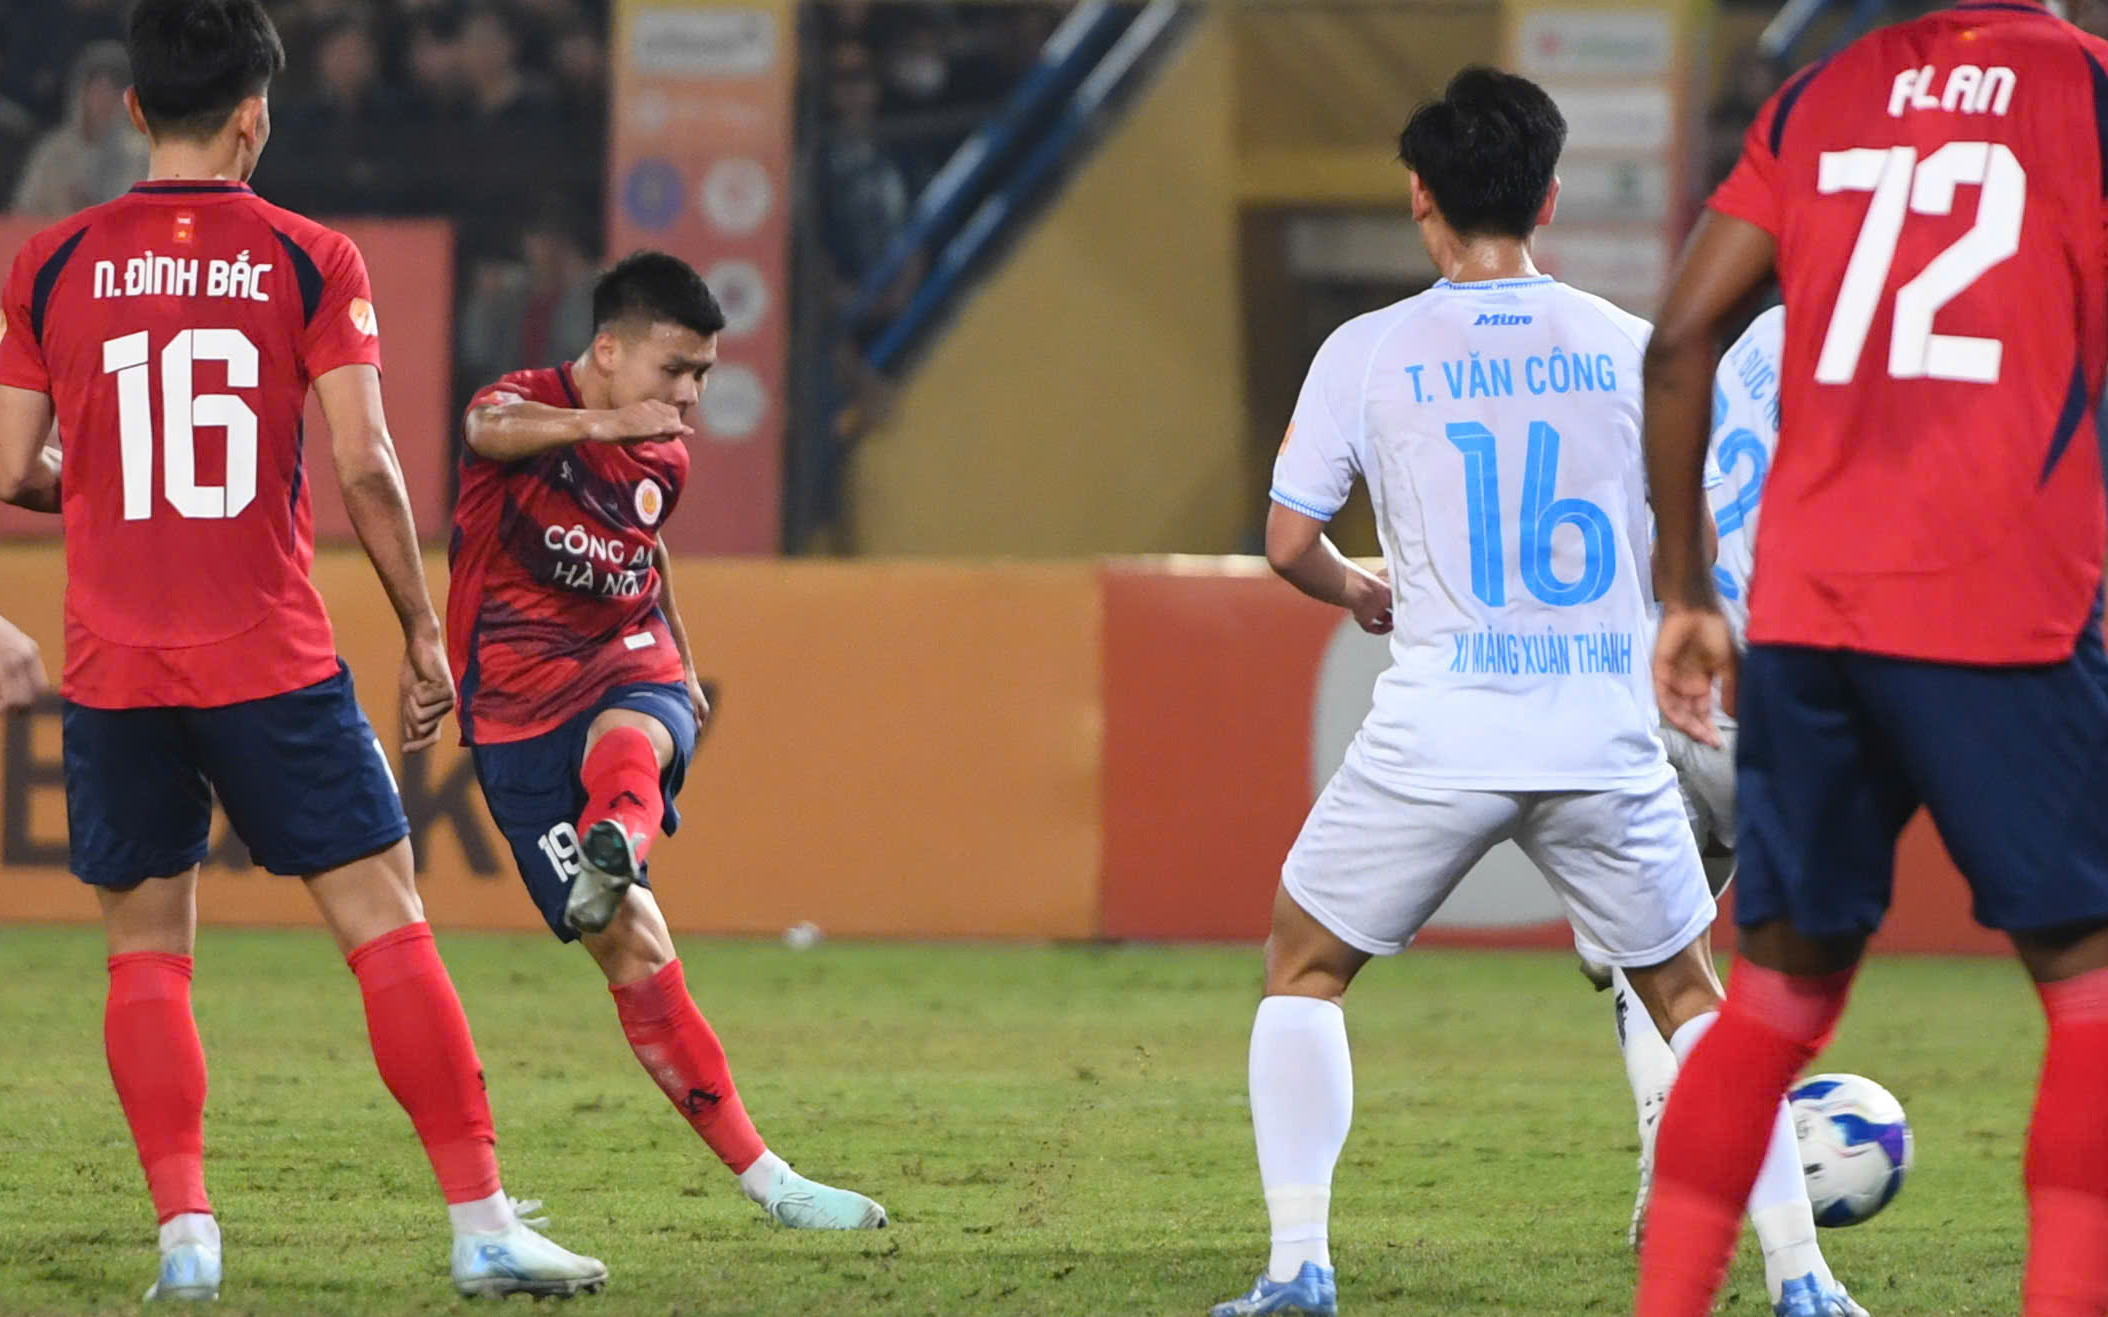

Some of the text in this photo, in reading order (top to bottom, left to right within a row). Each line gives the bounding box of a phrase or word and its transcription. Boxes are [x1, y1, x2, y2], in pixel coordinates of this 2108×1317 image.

[1887, 64, 2016, 117] FLAN
[206, 249, 273, 302] BẮC
[1813, 140, 2027, 385] 72
[1473, 313, 1533, 326] Mitre
[1404, 345, 1617, 404] T. VĂN CÔNG
[102, 328, 260, 521] 16
[1445, 421, 1616, 607] 16
[544, 524, 625, 565] CÔNG
[552, 561, 594, 590] HÀ
[1573, 622, 1632, 675] THÀNH
[537, 821, 582, 883] 19
